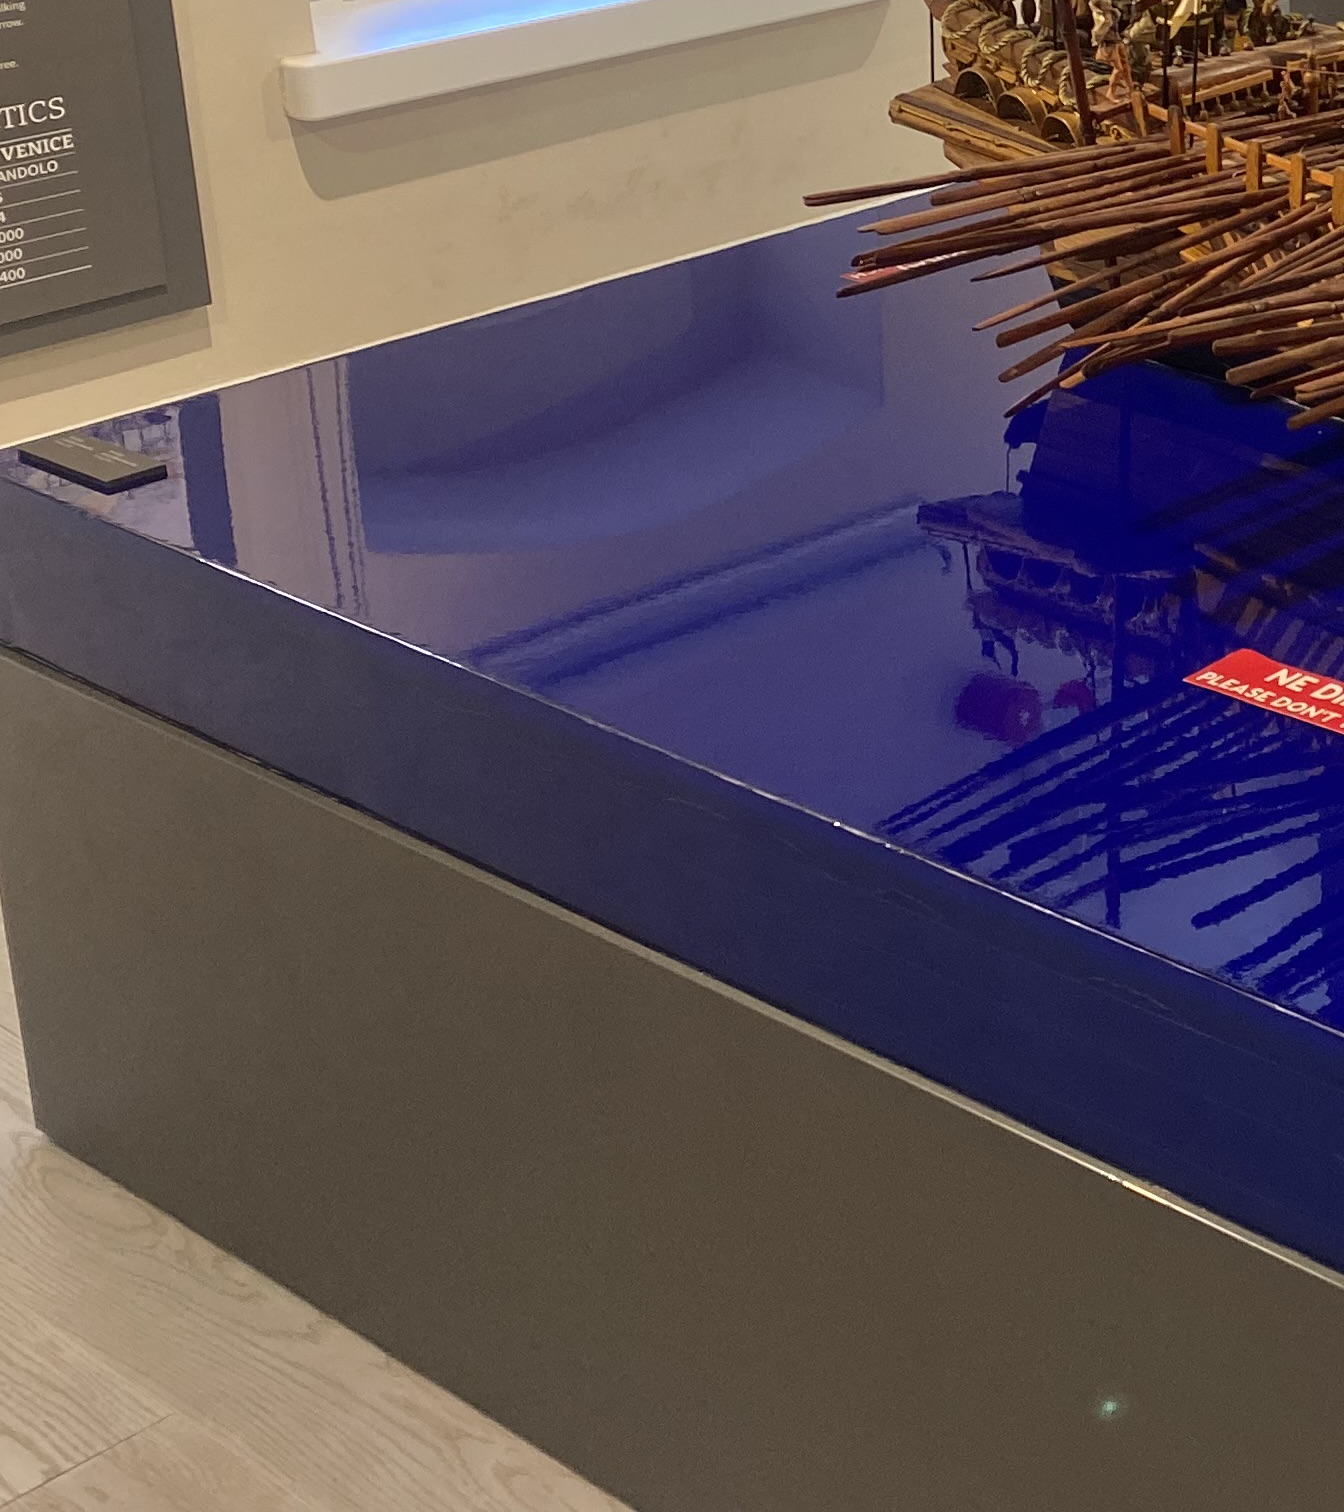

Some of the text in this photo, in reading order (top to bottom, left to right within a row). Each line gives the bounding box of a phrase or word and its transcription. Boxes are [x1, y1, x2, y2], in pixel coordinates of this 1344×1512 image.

[0, 96, 65, 129] TICS
[0, 134, 74, 161] VENICE
[1264, 668, 1319, 694] NE
[1196, 672, 1270, 703] PLEASE
[1270, 695, 1342, 723] DON'T
